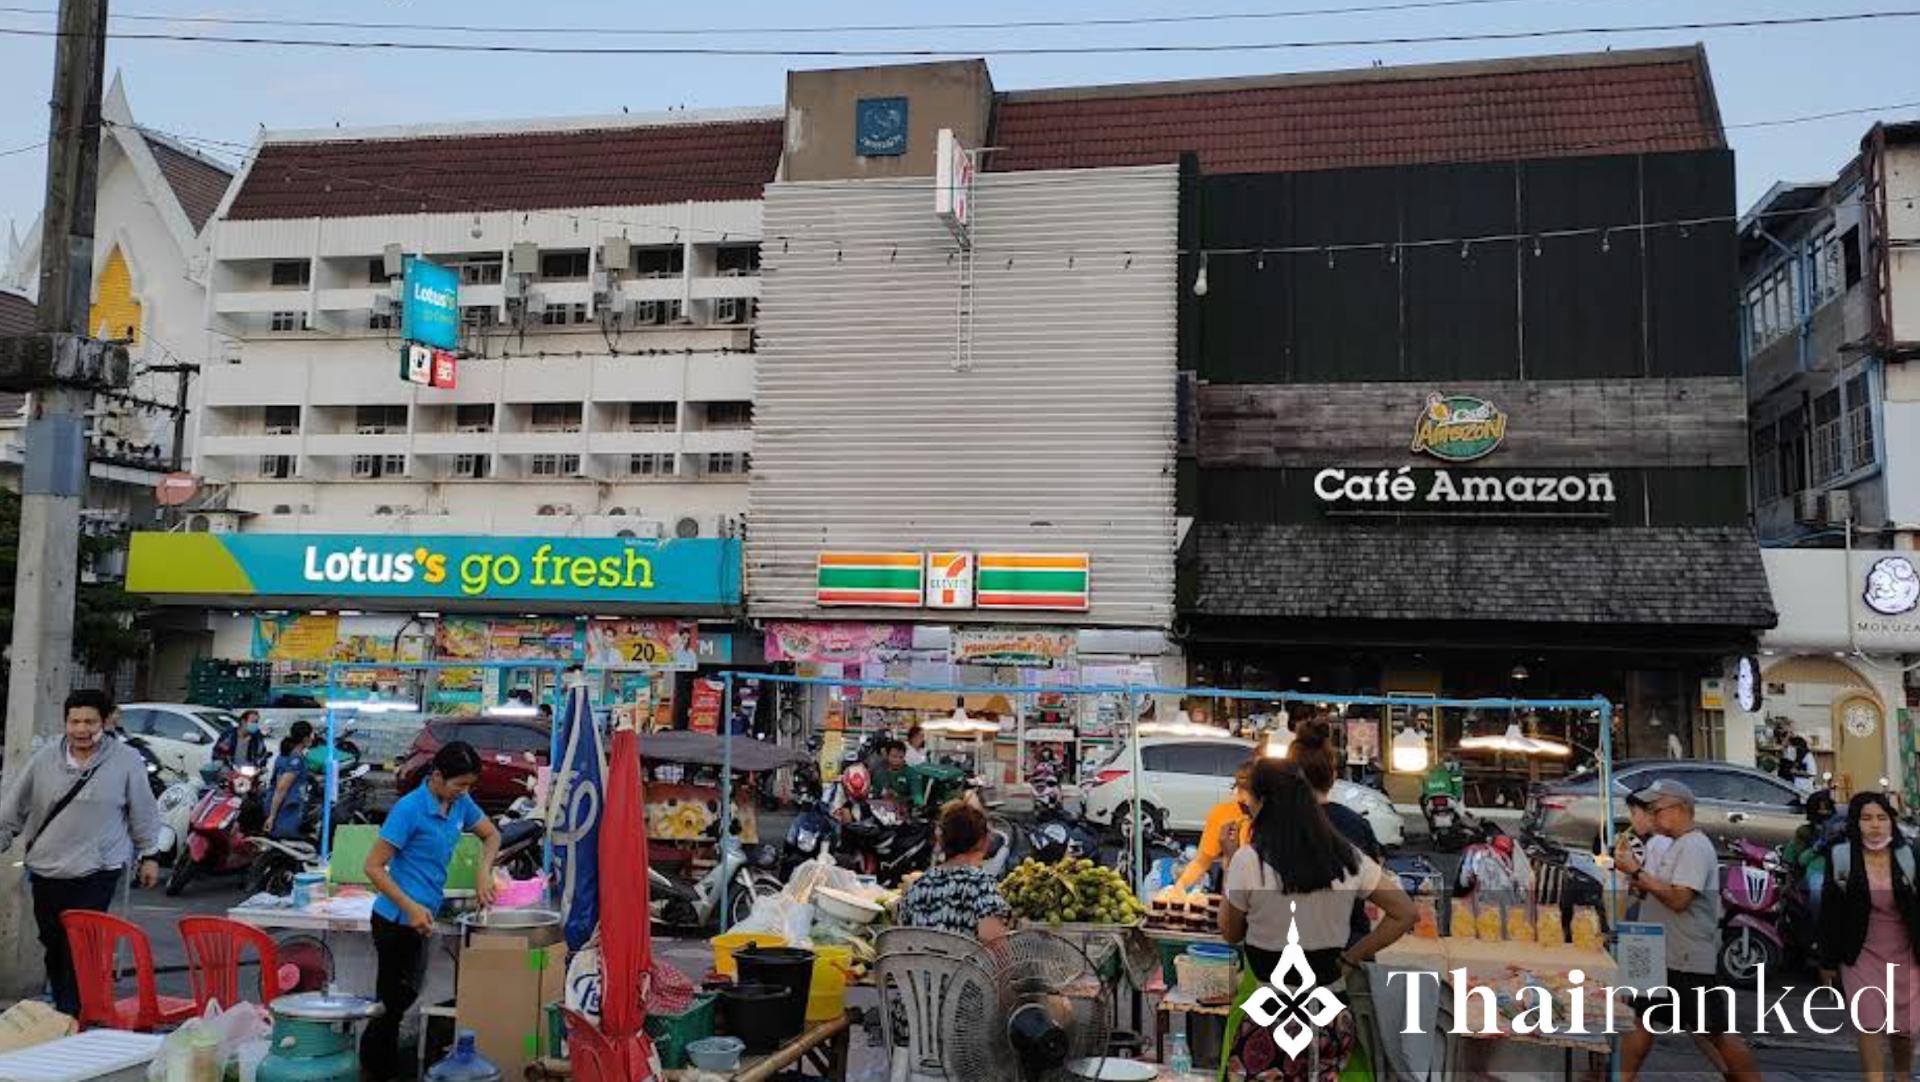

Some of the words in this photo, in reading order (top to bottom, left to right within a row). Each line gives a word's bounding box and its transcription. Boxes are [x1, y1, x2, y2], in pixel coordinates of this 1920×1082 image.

[1313, 466, 1416, 501] Café
[303, 546, 447, 584] Lotus's
[461, 553, 521, 595] go
[530, 544, 655, 588] fresh
[631, 642, 656, 663] 20
